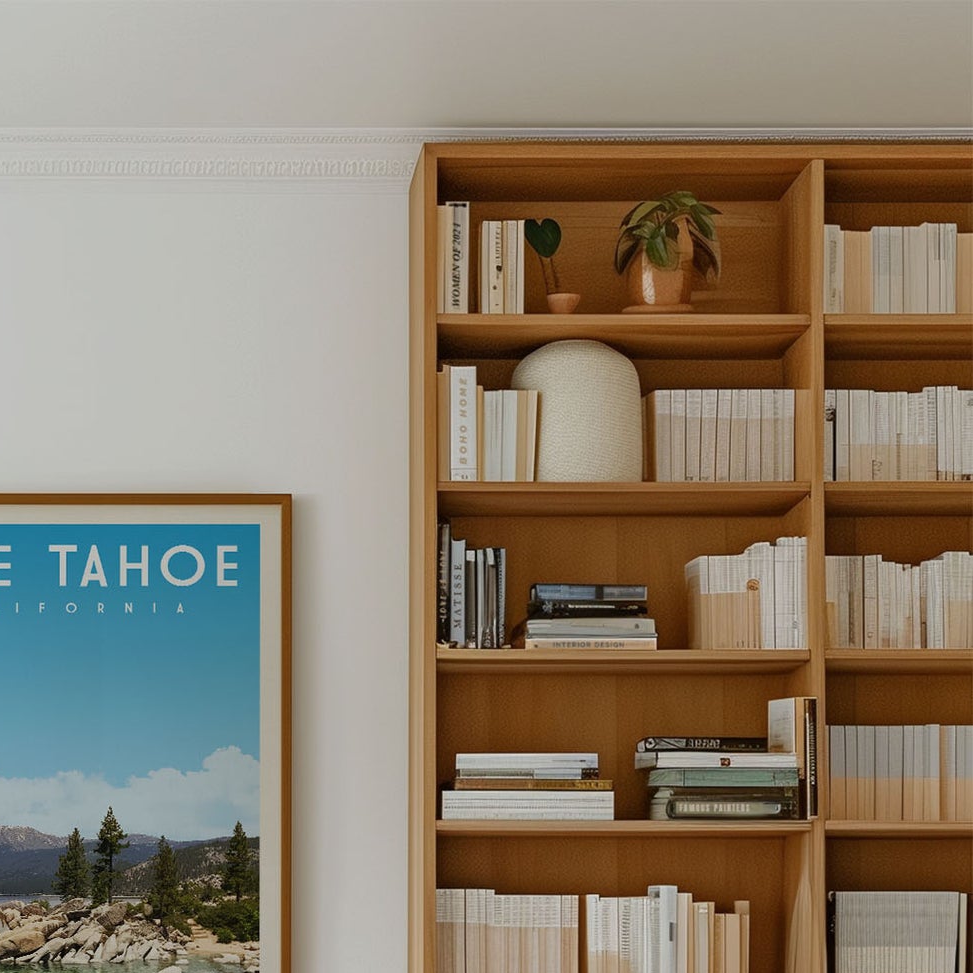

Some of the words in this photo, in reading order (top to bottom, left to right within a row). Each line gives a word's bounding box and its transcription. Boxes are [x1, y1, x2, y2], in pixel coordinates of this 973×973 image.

[451, 246, 461, 262] OF
[451, 264, 461, 307] WOMEN
[459, 377, 468, 417] HOME
[459, 425, 468, 464] BOHO
[48, 544, 239, 587] TAHOE
[453, 563, 462, 629] MATISSE
[678, 803, 710, 812] FAMOUS
[713, 803, 750, 812] PAINTERS
